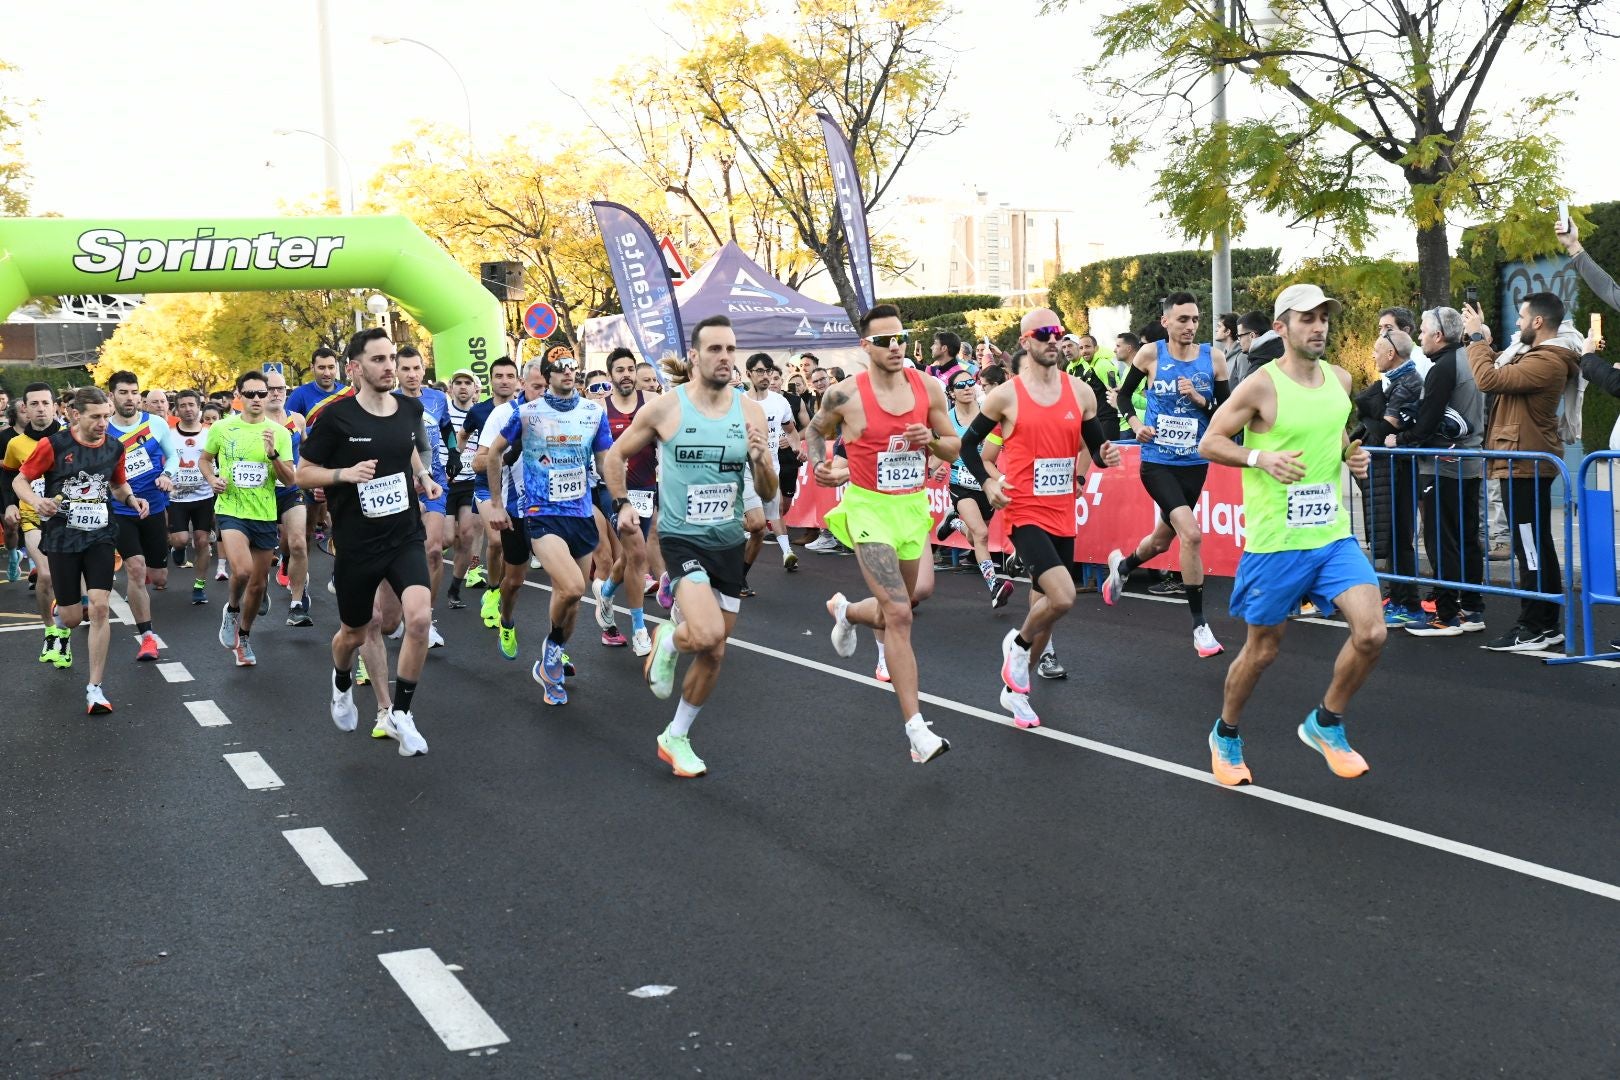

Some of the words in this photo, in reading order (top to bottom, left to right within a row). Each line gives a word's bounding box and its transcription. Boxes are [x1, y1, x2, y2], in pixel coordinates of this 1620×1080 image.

[73, 227, 345, 282] Sprinter
[728, 303, 808, 314] Alicante
[1161, 428, 1191, 440] 2097
[238, 472, 262, 482] 1952
[886, 467, 919, 481] 1824
[1041, 474, 1070, 487] 2037
[364, 478, 402, 491] CASTILLOS
[557, 481, 582, 493] 1981
[694, 487, 733, 496] CASTILLOS
[369, 490, 402, 509] 1965
[696, 500, 729, 514] 1779
[1297, 502, 1331, 518] 1739
[76, 514, 102, 525] 1814
